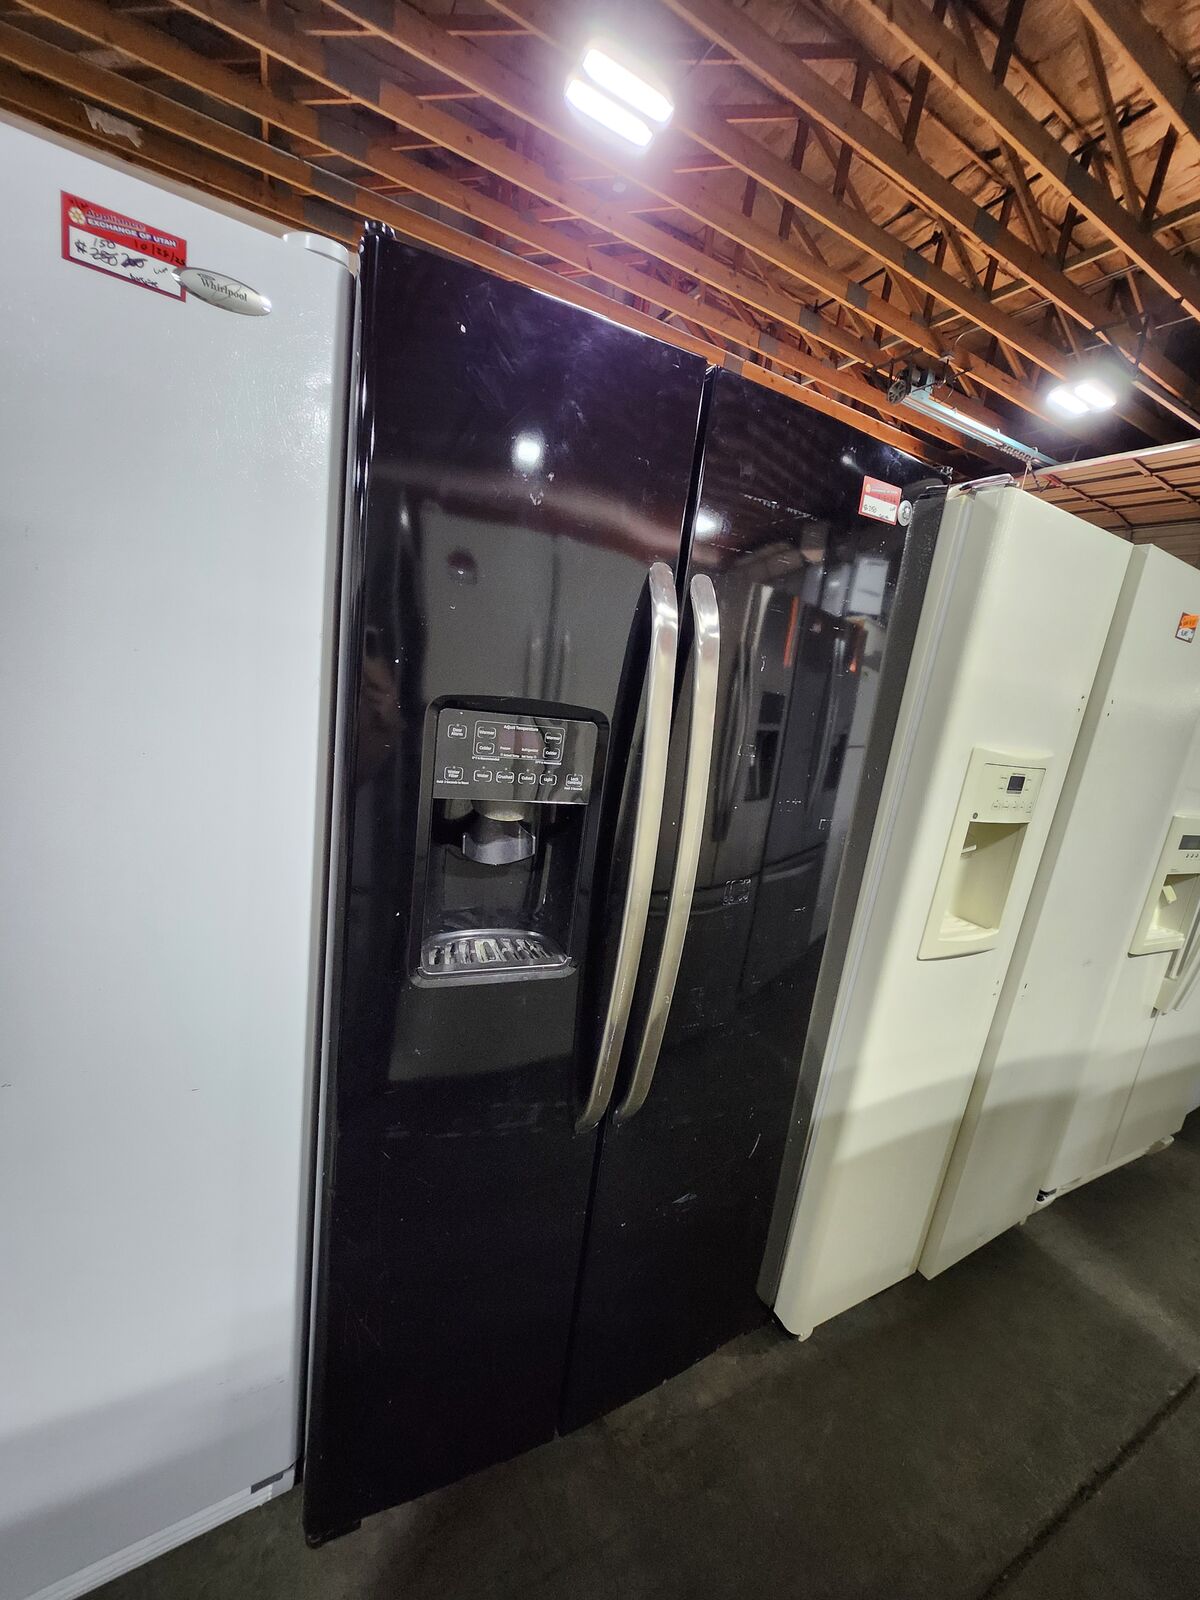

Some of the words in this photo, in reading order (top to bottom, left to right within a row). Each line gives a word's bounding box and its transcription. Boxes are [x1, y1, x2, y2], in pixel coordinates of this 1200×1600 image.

[87, 218, 138, 237] EXCHANGE
[139, 231, 152, 240] OF
[200, 277, 248, 302] Whirlpool
